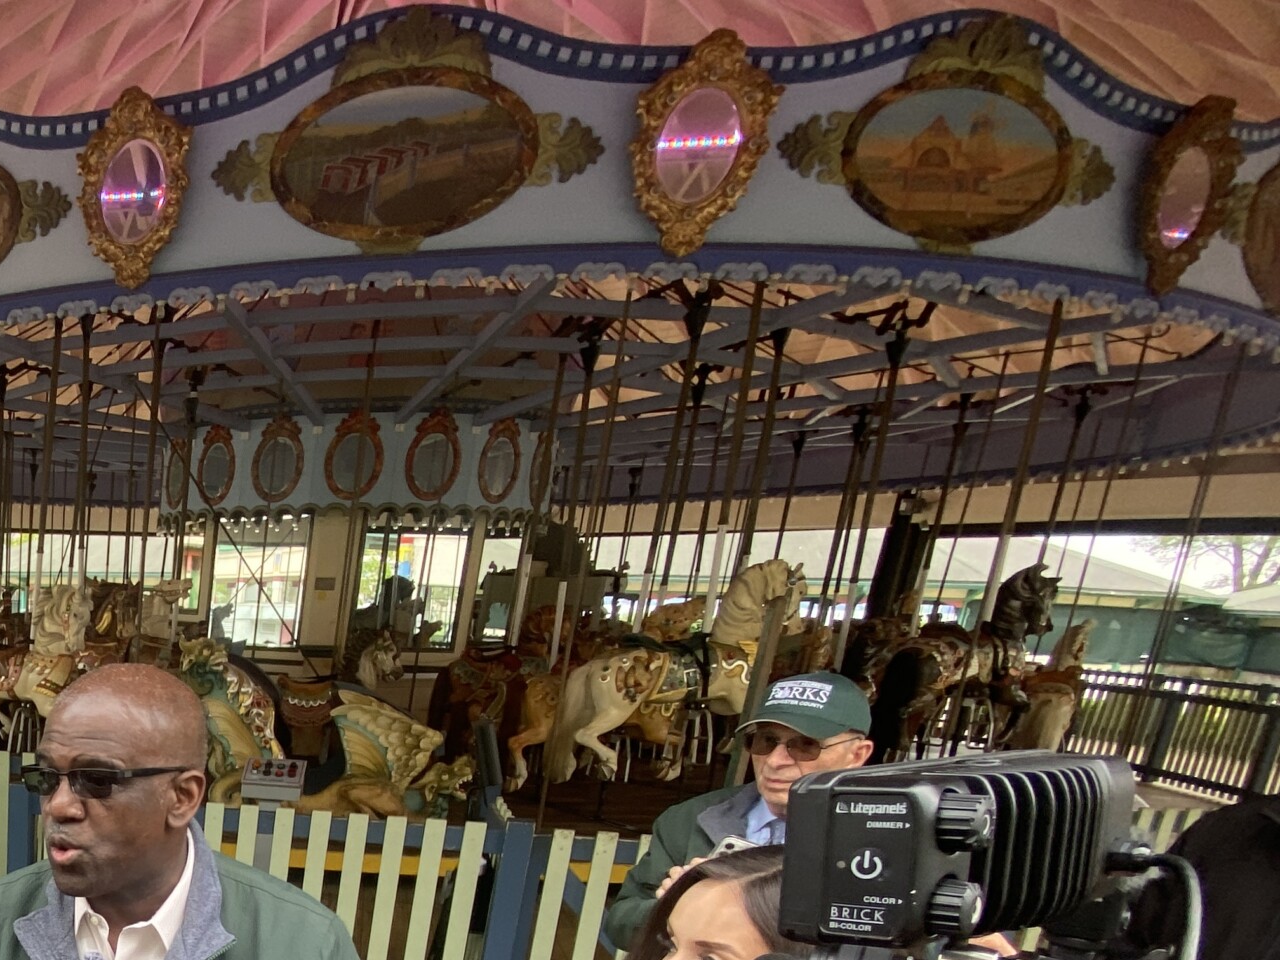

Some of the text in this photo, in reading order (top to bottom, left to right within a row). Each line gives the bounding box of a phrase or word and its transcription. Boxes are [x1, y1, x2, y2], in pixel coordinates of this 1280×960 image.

[850, 802, 907, 816] Litepanels
[866, 821, 903, 829] DIMMER
[863, 895, 896, 905] COLOR
[830, 906, 884, 921] BRICK
[829, 921, 872, 932] BI-COLOR
